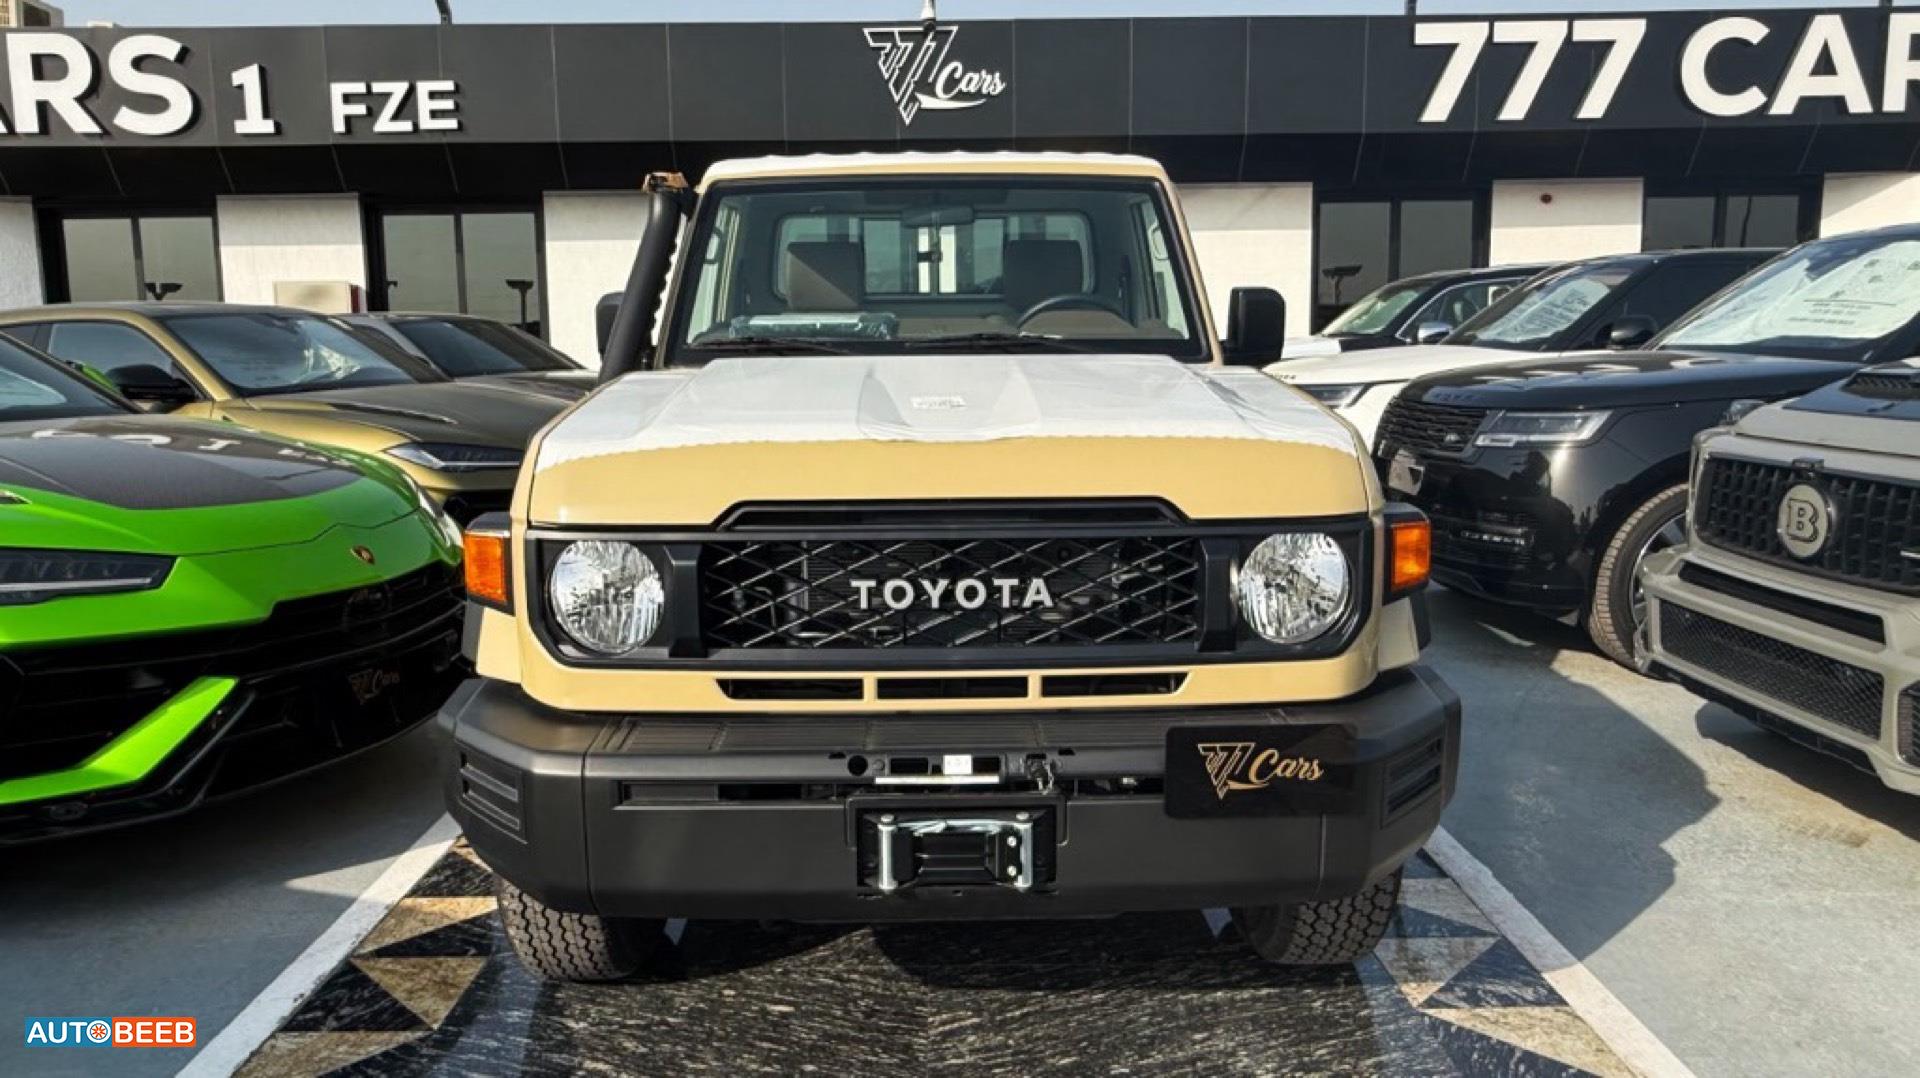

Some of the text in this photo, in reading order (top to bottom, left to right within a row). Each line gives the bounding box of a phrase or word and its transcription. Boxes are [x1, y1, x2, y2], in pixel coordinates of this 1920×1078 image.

[0, 33, 459, 135] RS 1 FZE
[935, 60, 1006, 99] Cars
[1413, 18, 1647, 123] 777
[850, 578, 1054, 610] TOYOTA
[1248, 747, 1325, 785] Cars
